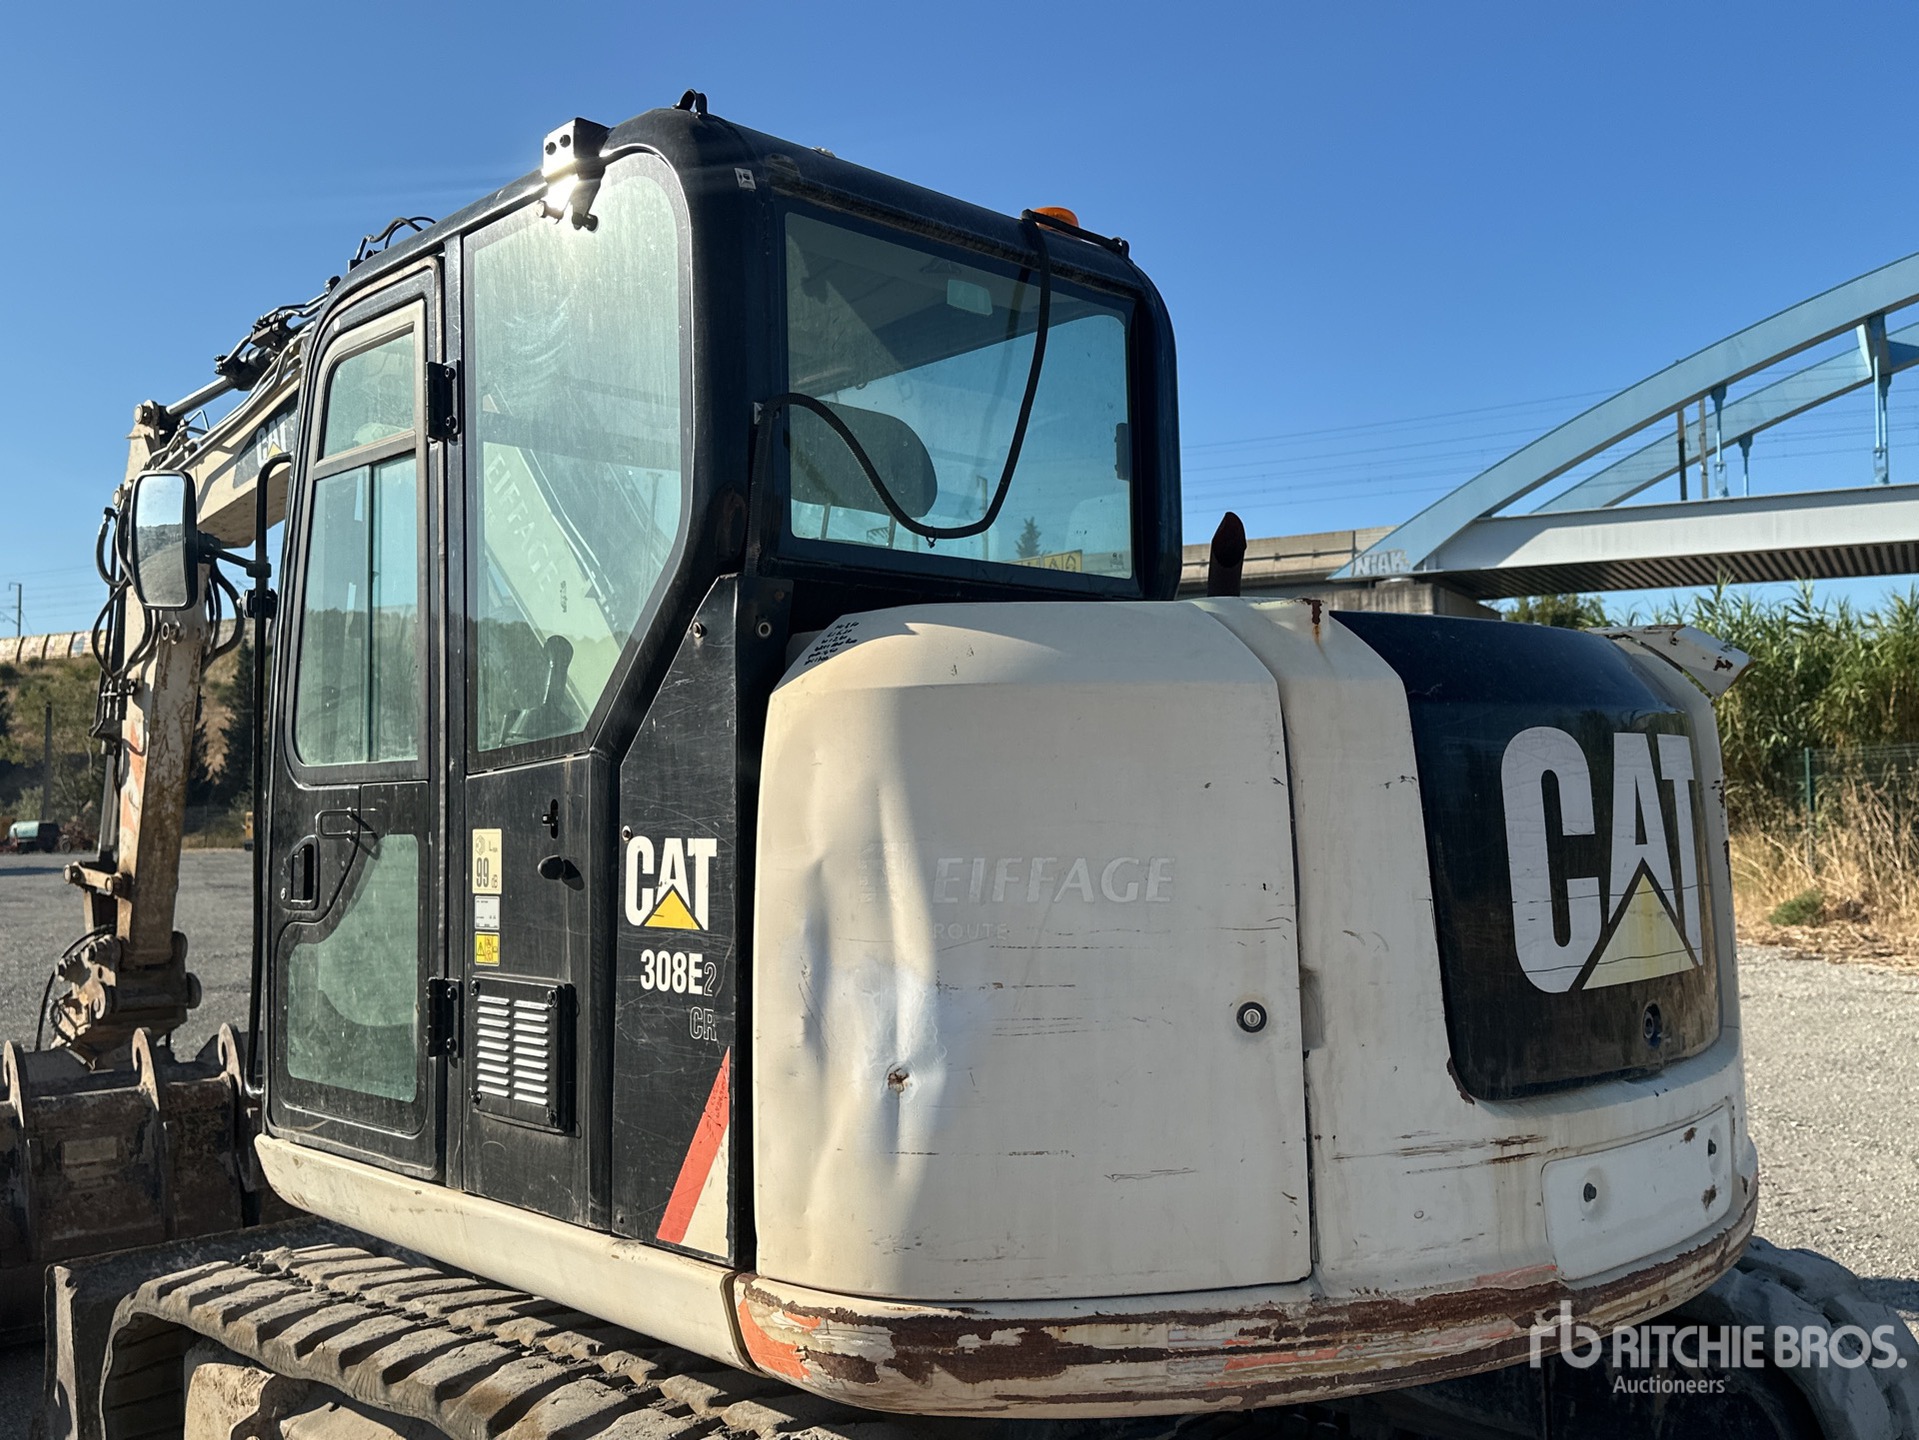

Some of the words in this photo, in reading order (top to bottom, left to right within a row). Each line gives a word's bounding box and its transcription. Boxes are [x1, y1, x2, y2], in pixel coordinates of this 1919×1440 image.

[256, 412, 289, 469] CAT
[476, 857, 490, 888] 99
[625, 835, 717, 931] CAT
[932, 856, 1176, 904] EIFFAGE
[1501, 726, 1703, 994] CAT
[932, 922, 1009, 941] ROUTE
[689, 1006, 718, 1041] CR
